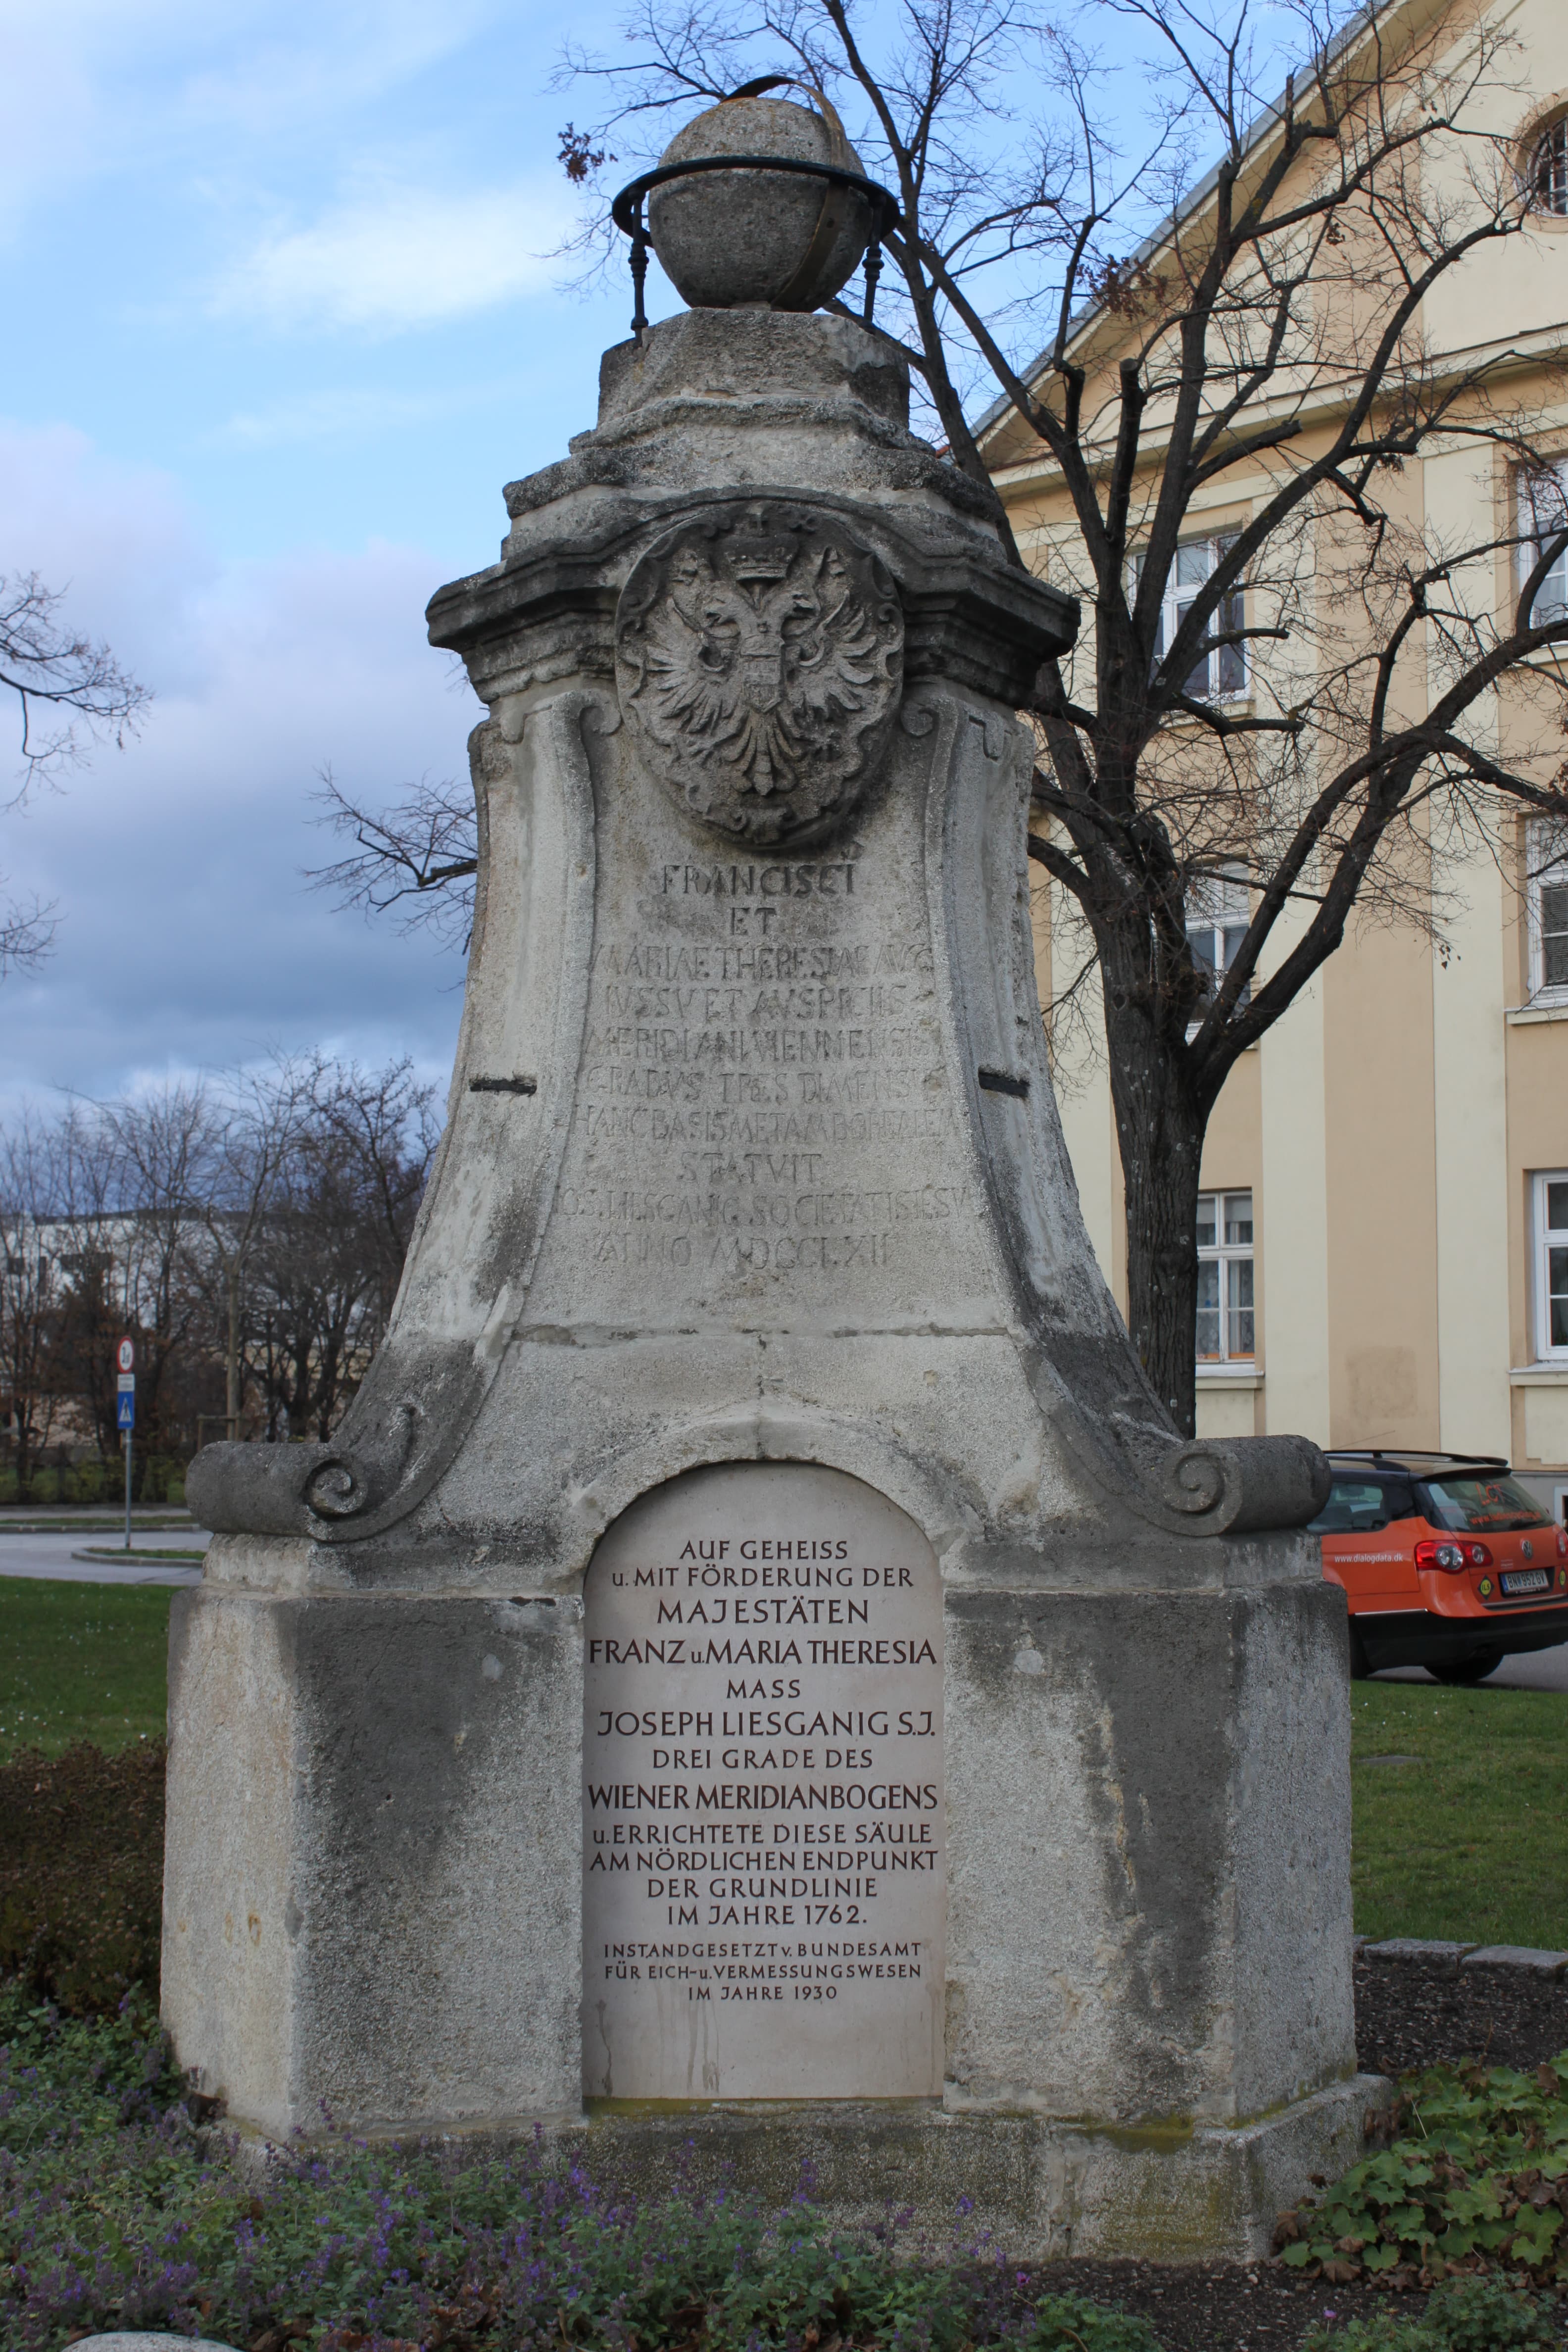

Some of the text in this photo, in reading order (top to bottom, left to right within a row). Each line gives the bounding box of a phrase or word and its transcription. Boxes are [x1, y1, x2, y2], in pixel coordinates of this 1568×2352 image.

[662, 863, 857, 898] FRANCISCI
[729, 907, 776, 935] ET
[679, 1540, 848, 1560] AUF GEHEISS
[1334, 1553, 1403, 1564] www.dialogdata.dk
[633, 1567, 680, 1587] MIT
[687, 1563, 853, 1587] FÖRDERUNG
[862, 1567, 914, 1588] DER
[657, 1595, 868, 1624] MAJESTÄTEN
[589, 1638, 686, 1665] FRANZ
[806, 1638, 937, 1665] THERESIA
[726, 1678, 801, 1699] MASS
[597, 1711, 936, 1737] JOSEPH LIESGANIG S.J.
[653, 1749, 873, 1769] DREI GRADE DES
[588, 1783, 938, 1811] WIENER MERIDIANBOGENS
[613, 1824, 764, 1845] ERRICHTETE
[773, 1823, 847, 1844] DIESE
[854, 1821, 932, 1844] SÄULE
[589, 1847, 939, 1871] AM NÖRDLICHEN ENDPUNKT
[647, 1877, 878, 1899] DER GRUNDLINIE
[668, 1904, 867, 1926] IM JAHRE 1762.
[604, 1943, 778, 1959] INSTANDGESETZT
[797, 1942, 922, 1957] BUNDESAMT
[605, 1960, 641, 1980] FÜR
[688, 1985, 837, 2001] IM JAHRE 1930
